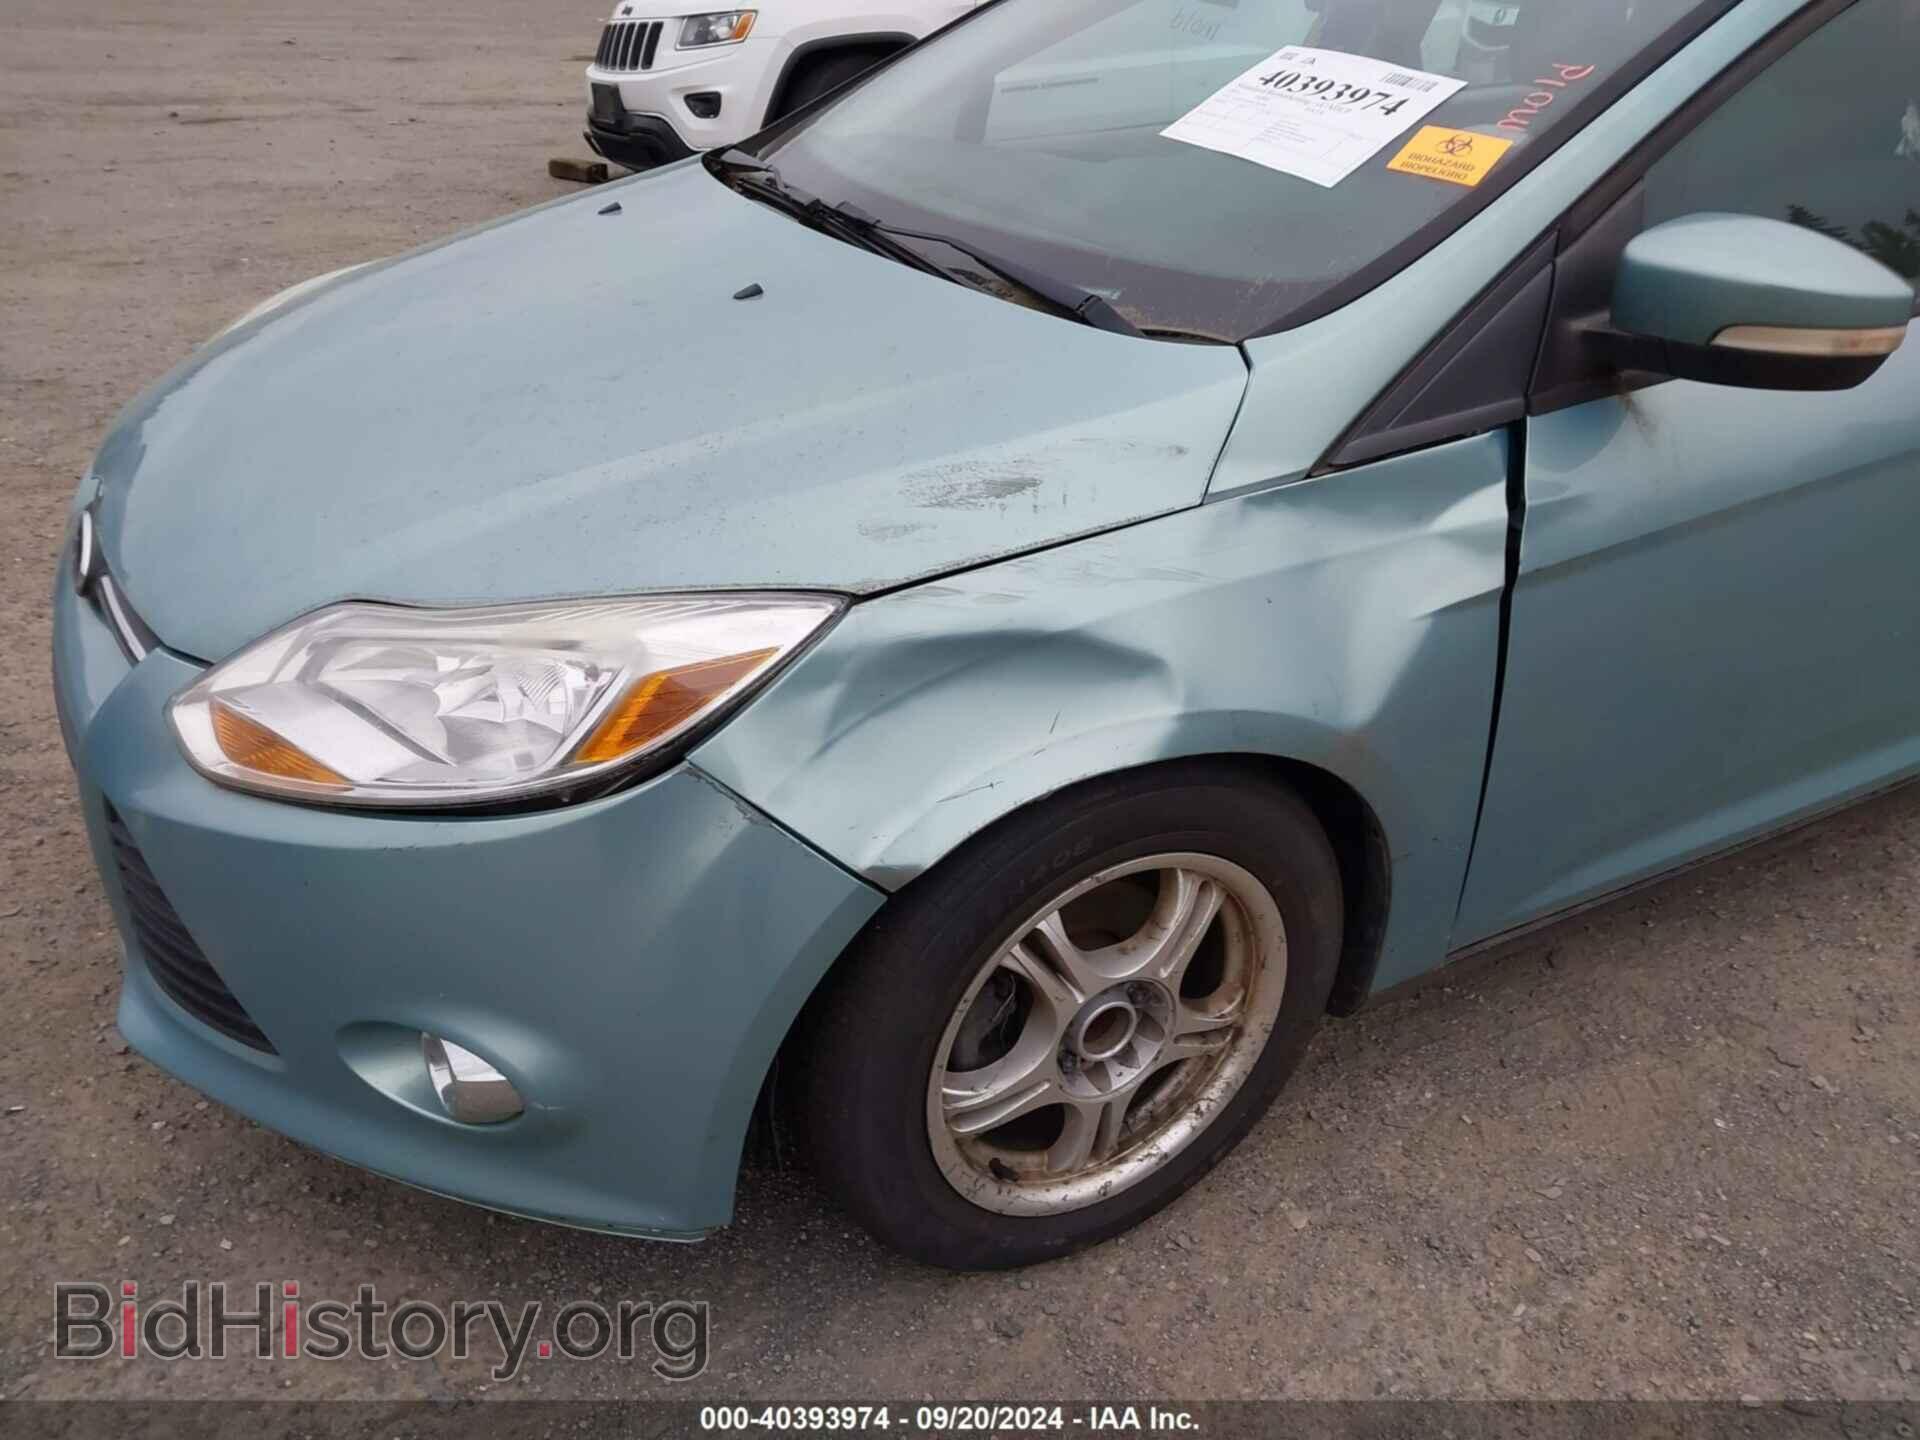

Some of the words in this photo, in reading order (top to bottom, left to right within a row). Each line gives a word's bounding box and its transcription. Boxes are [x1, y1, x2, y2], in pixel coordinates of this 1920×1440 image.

[1259, 69, 1410, 116] 40393974
[1496, 63, 1595, 131] mold
[1407, 151, 1476, 172] BIOHAZARD
